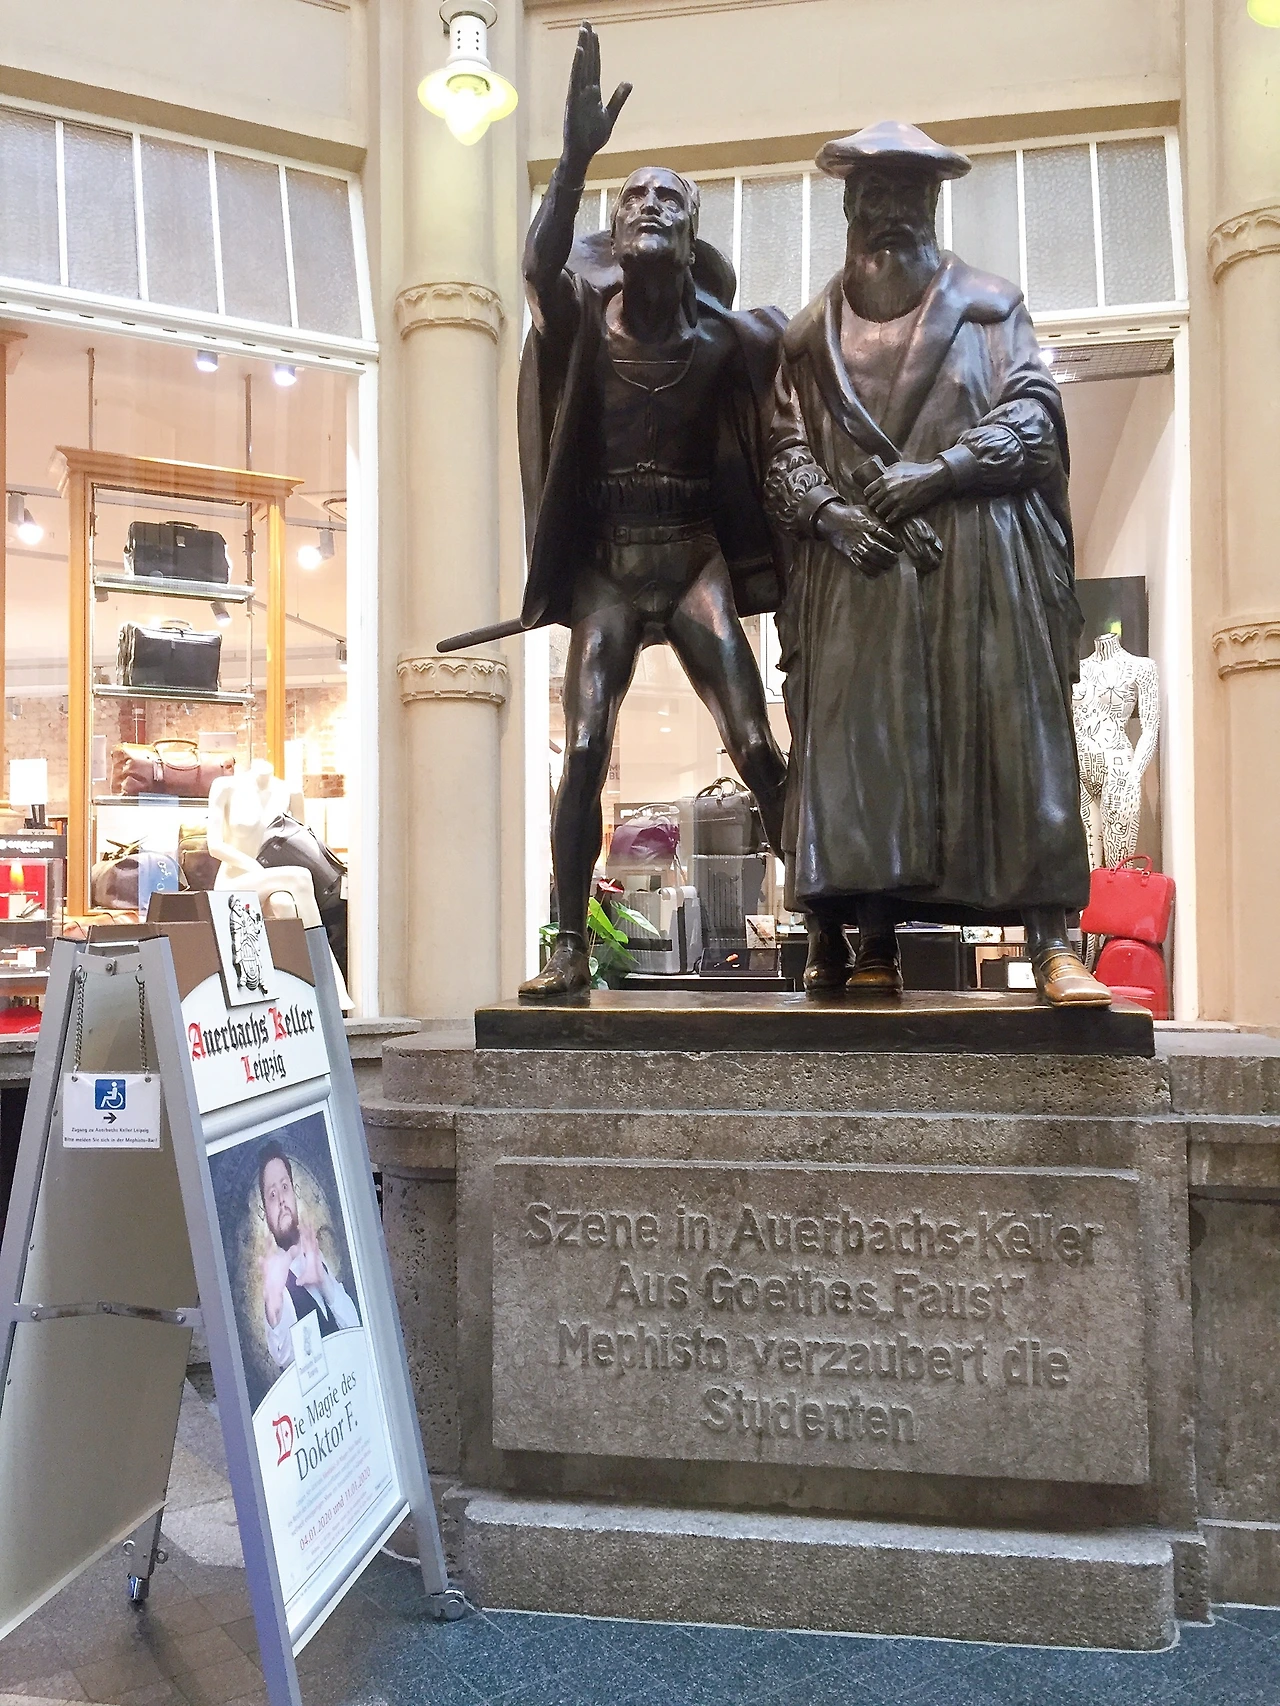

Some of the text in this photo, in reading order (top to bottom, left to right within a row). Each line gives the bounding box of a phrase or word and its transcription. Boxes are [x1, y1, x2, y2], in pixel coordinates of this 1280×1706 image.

[187, 1004, 315, 1061] Auerbachs Keller
[240, 1050, 287, 1084] Leipzig
[525, 1201, 1104, 1268] Szene in Auerbachs-Keller
[605, 1260, 690, 1311] Aus
[702, 1262, 879, 1317] Goethes
[556, 1320, 1072, 1387] Mephisto verzaubert die
[272, 1412, 307, 1468] Die
[306, 1386, 340, 1427] Magie
[341, 1371, 358, 1397] des
[294, 1418, 345, 1481] Doktor
[344, 1400, 359, 1433] F.
[702, 1386, 918, 1443] Studenten
